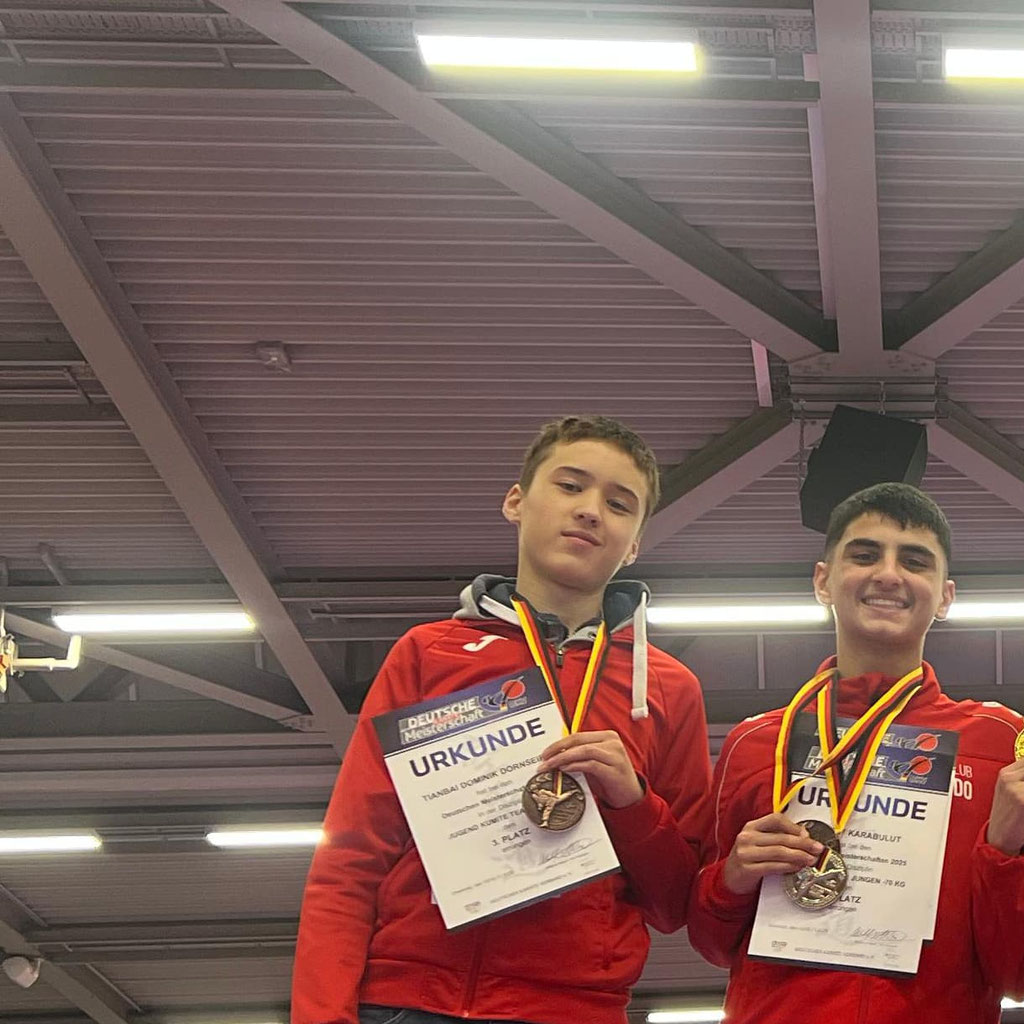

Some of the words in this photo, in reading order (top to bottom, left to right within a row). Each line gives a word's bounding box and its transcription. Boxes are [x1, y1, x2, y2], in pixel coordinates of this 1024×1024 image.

[408, 697, 477, 728] DEUTSCHE
[404, 709, 484, 742] Meisterschaft
[409, 717, 546, 777] URKUNDE
[460, 771, 499, 789] DOMINIK
[500, 756, 543, 774] DORNSEI
[510, 808, 526, 818] TEA
[798, 785, 928, 820] URUNDE
[501, 827, 531, 844] PLATZ
[848, 830, 901, 843] KARABULUT
[851, 875, 881, 884] JUNGEN
[894, 880, 906, 888] KG
[840, 896, 862, 904] LATZ
